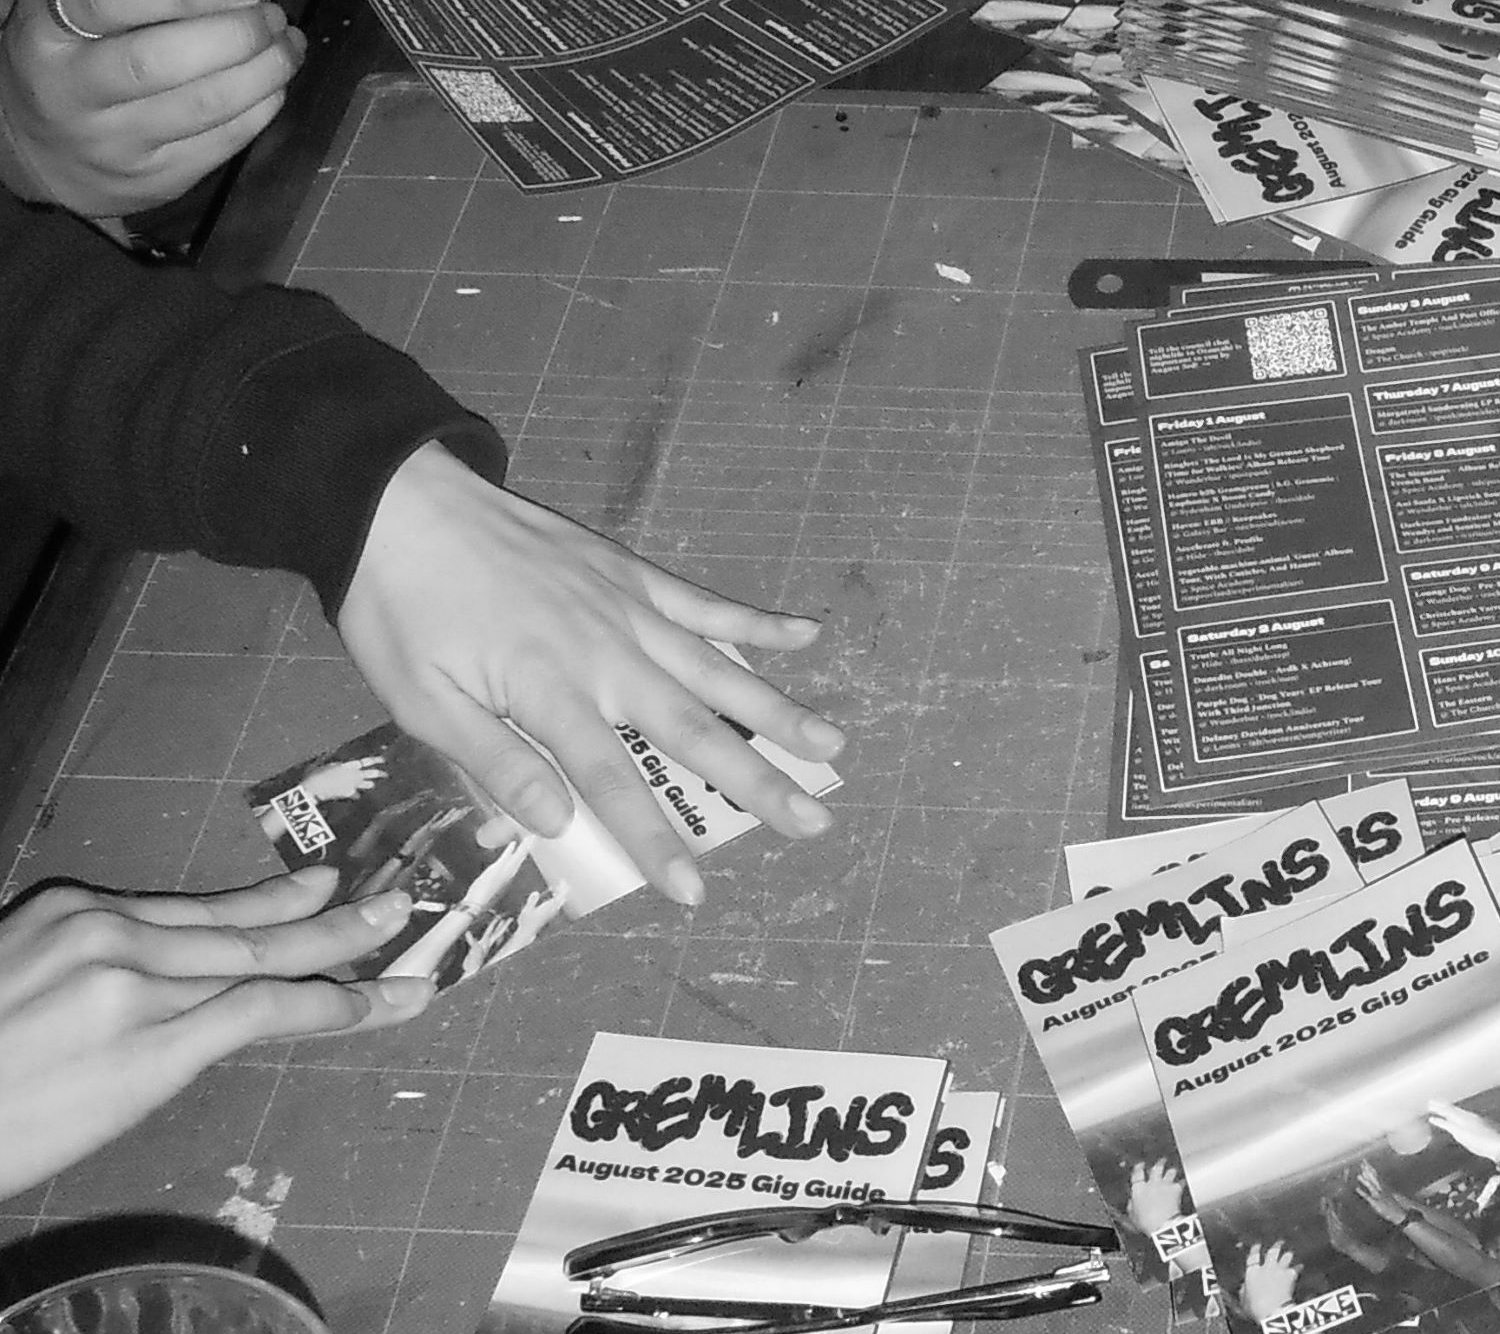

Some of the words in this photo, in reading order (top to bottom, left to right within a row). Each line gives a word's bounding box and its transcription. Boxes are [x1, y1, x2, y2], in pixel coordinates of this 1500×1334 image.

[1357, 300, 1408, 315] Sunday
[1410, 299, 1421, 309] 3
[1423, 293, 1471, 308] August
[1373, 383, 1439, 401] Thursday
[1440, 383, 1451, 393] 7
[1452, 378, 1500, 392] August
[1157, 415, 1204, 431] Friday
[1206, 416, 1214, 425] 1
[1215, 412, 1266, 426] August
[1385, 450, 1432, 463] Friday
[1446, 444, 1497, 457] August
[1410, 566, 1478, 581] Saturday
[1187, 626, 1257, 643] Saturday
[1258, 624, 1270, 634] 2
[1271, 617, 1325, 632] August
[1429, 652, 1484, 667] Sunday
[1017, 837, 1331, 1006] GREMLINS
[1154, 880, 1476, 1068] GREMLINS
[1173, 1042, 1275, 1098] August
[1277, 1009, 1358, 1053] 2025
[1361, 986, 1410, 1019] Gig
[1411, 948, 1491, 993] Guide
[568, 1074, 915, 1162] GREMLINS
[553, 1153, 661, 1183] August
[665, 1166, 748, 1193] 2025
[751, 1173, 799, 1202] Gig
[803, 1179, 887, 1204] Guide
